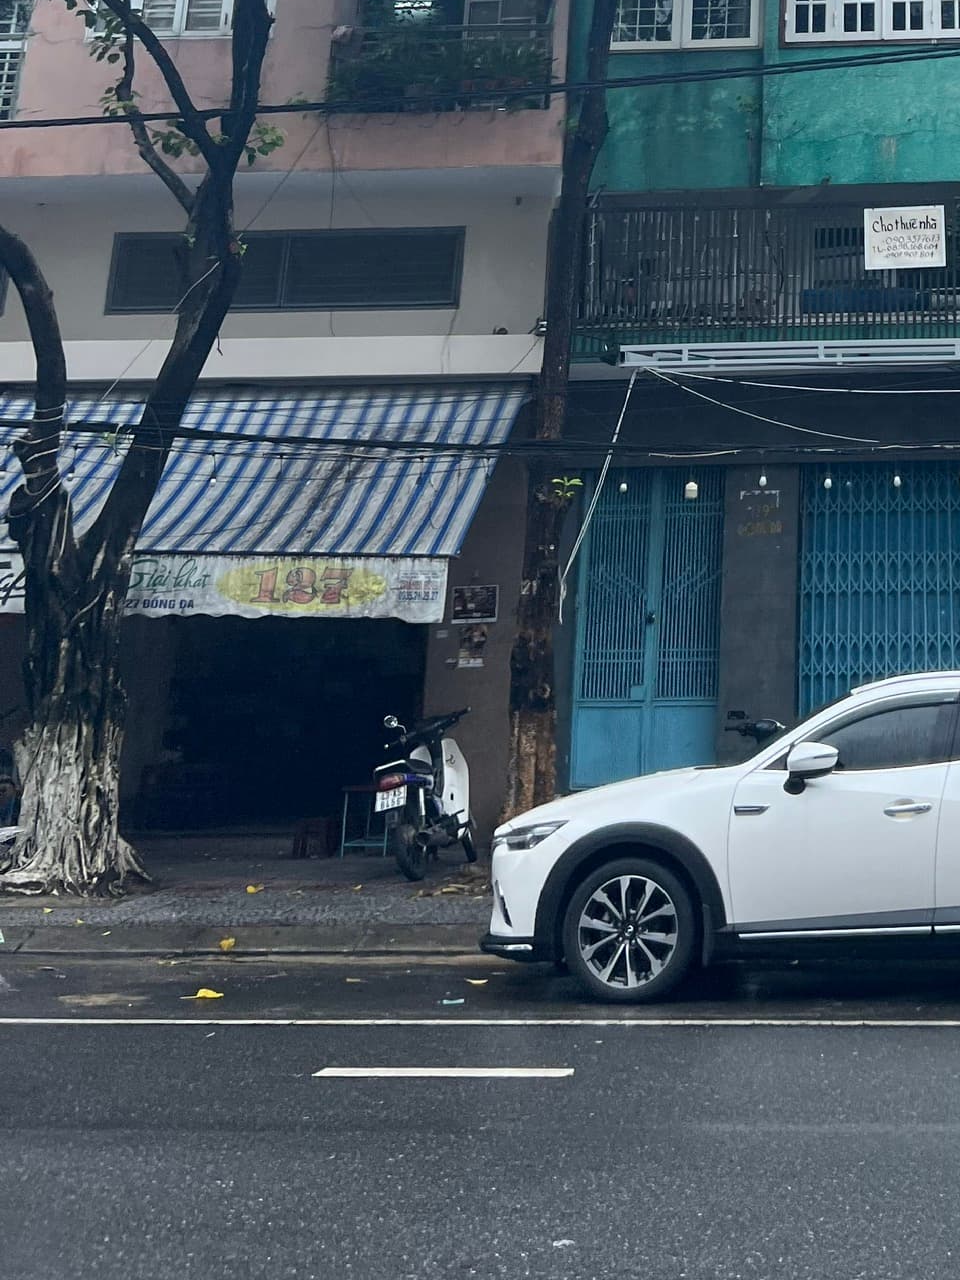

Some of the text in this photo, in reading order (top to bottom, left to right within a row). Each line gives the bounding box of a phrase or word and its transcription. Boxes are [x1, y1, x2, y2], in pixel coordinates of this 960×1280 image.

[872, 215, 894, 233] Cho
[919, 215, 937, 230] nhà
[250, 566, 354, 604] 127
